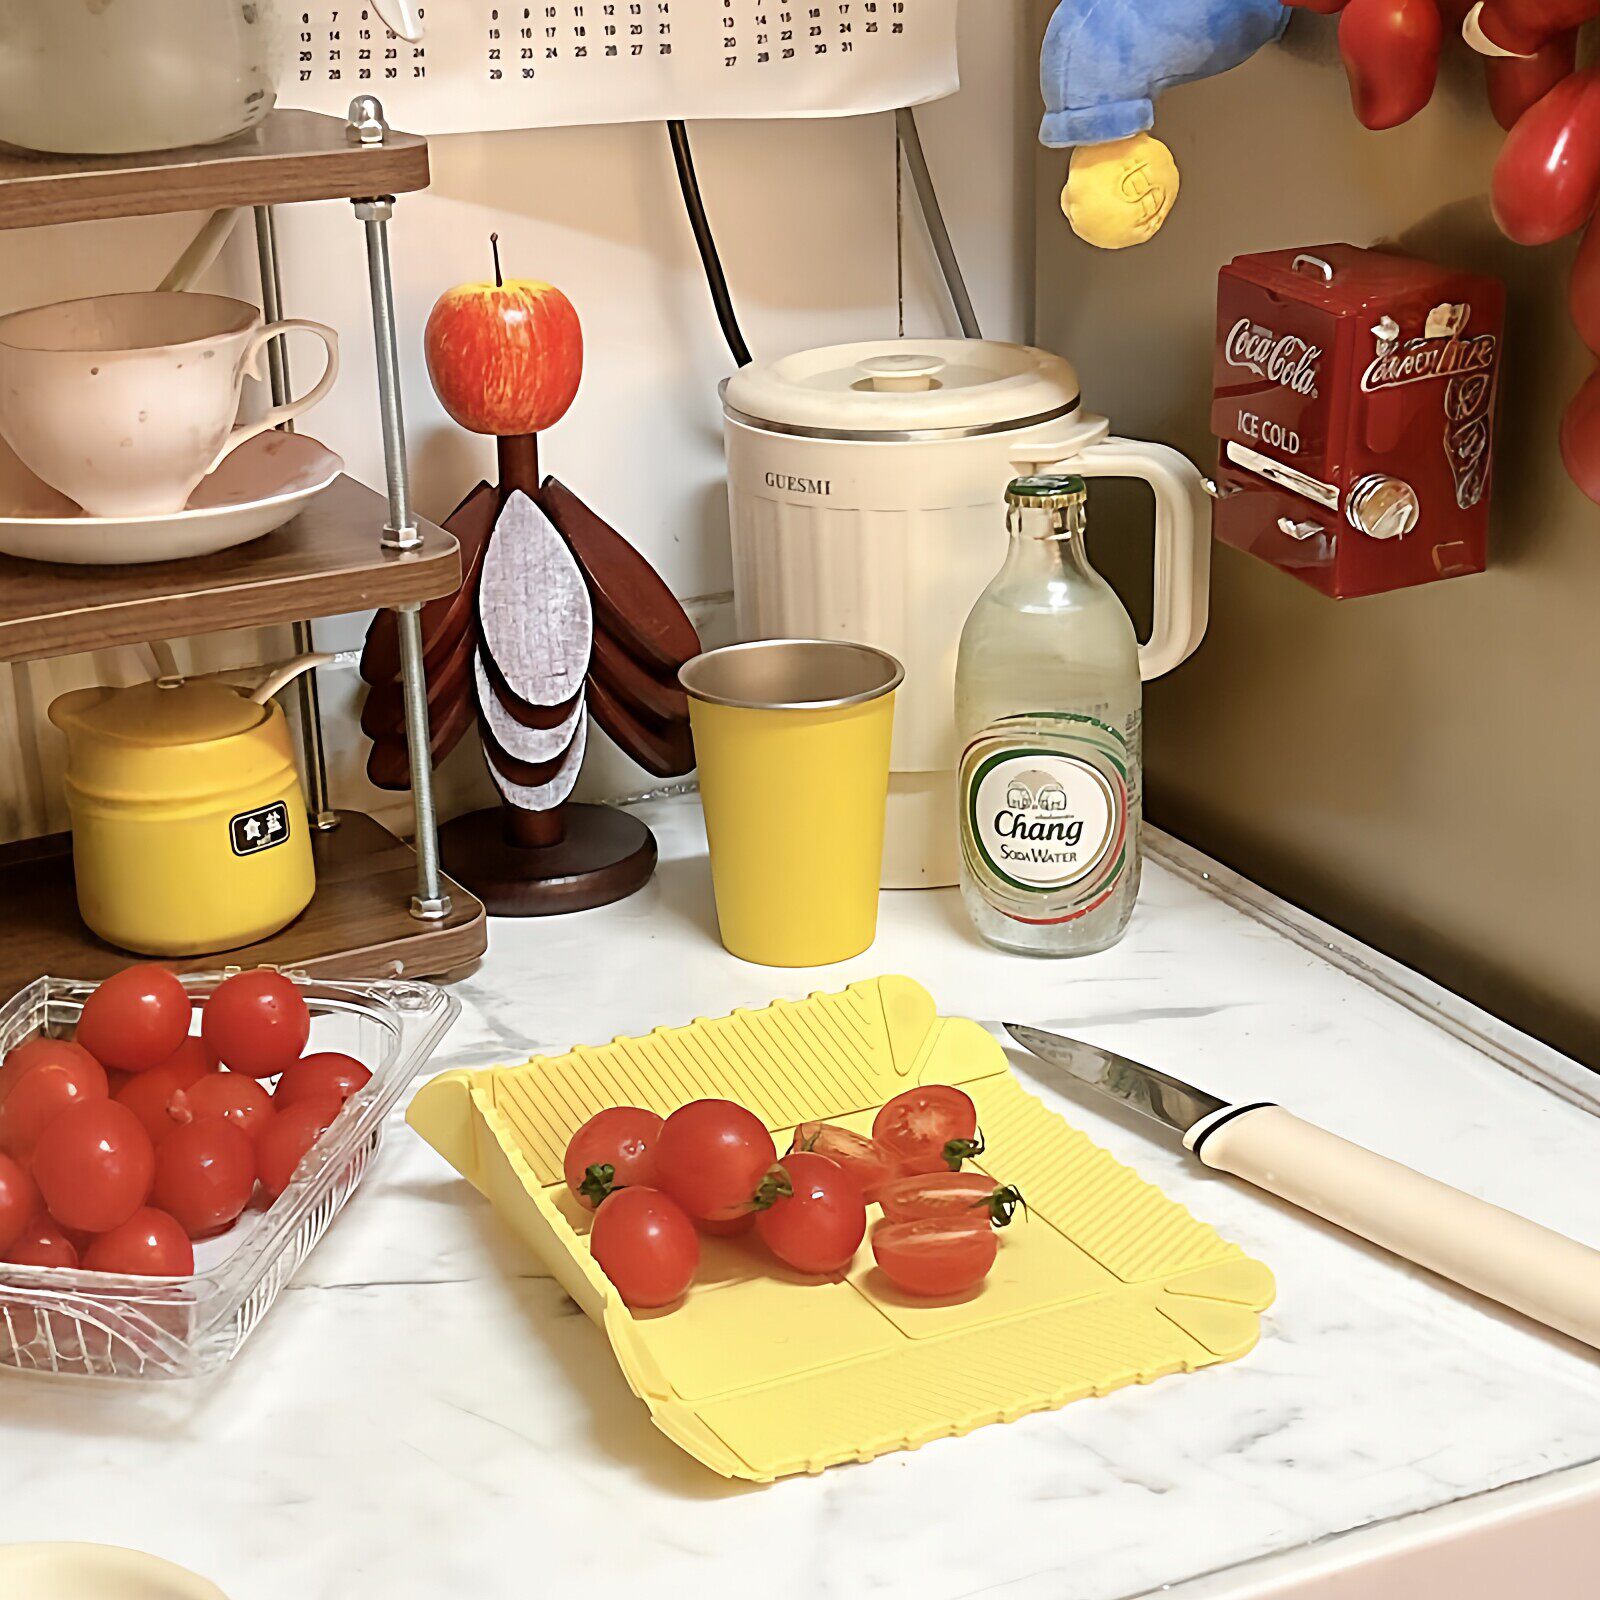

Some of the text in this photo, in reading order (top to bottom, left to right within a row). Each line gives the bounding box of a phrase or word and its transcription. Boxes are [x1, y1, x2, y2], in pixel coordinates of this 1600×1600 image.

[332, 11, 338, 22] 7
[545, 6, 556, 17] 10
[574, 6, 583, 16] 11
[603, 5, 615, 15] 12
[630, 4, 641, 14] 13
[658, 3, 669, 13] 14
[723, 17, 734, 27] 13
[756, 15, 767, 25] 14
[780, 12, 791, 22] 15
[839, 4, 849, 14] 17
[300, 32, 311, 42] 13
[329, 31, 340, 40] 14
[360, 30, 370, 39] 15
[489, 29, 500, 39] 15
[545, 27, 556, 37] 17
[574, 26, 586, 36] 18
[630, 25, 642, 35] 20
[659, 24, 671, 34] 21
[724, 37, 736, 47] 20
[757, 34, 767, 44] 21
[781, 30, 792, 40] 22
[810, 26, 821, 36] 23
[840, 23, 851, 33] 24
[866, 22, 878, 32] 25
[300, 48, 424, 61] 20 21 22 23 24
[489, 49, 500, 59] 22
[521, 48, 533, 59] 23
[546, 47, 557, 58] 24
[575, 46, 587, 57] 25
[631, 45, 643, 55] 27
[725, 56, 737, 67] 27
[815, 44, 827, 54] 30
[842, 42, 852, 52] 31
[300, 70, 311, 81] 27
[329, 69, 341, 79] 28
[385, 68, 397, 78] 30
[414, 67, 425, 77] 31
[490, 68, 534, 79] 29 30
[1237, 409, 1300, 454] ICE COLD
[765, 472, 830, 495] GUESMI
[994, 810, 1084, 846] Chang
[1031, 848, 1077, 863] WATER
